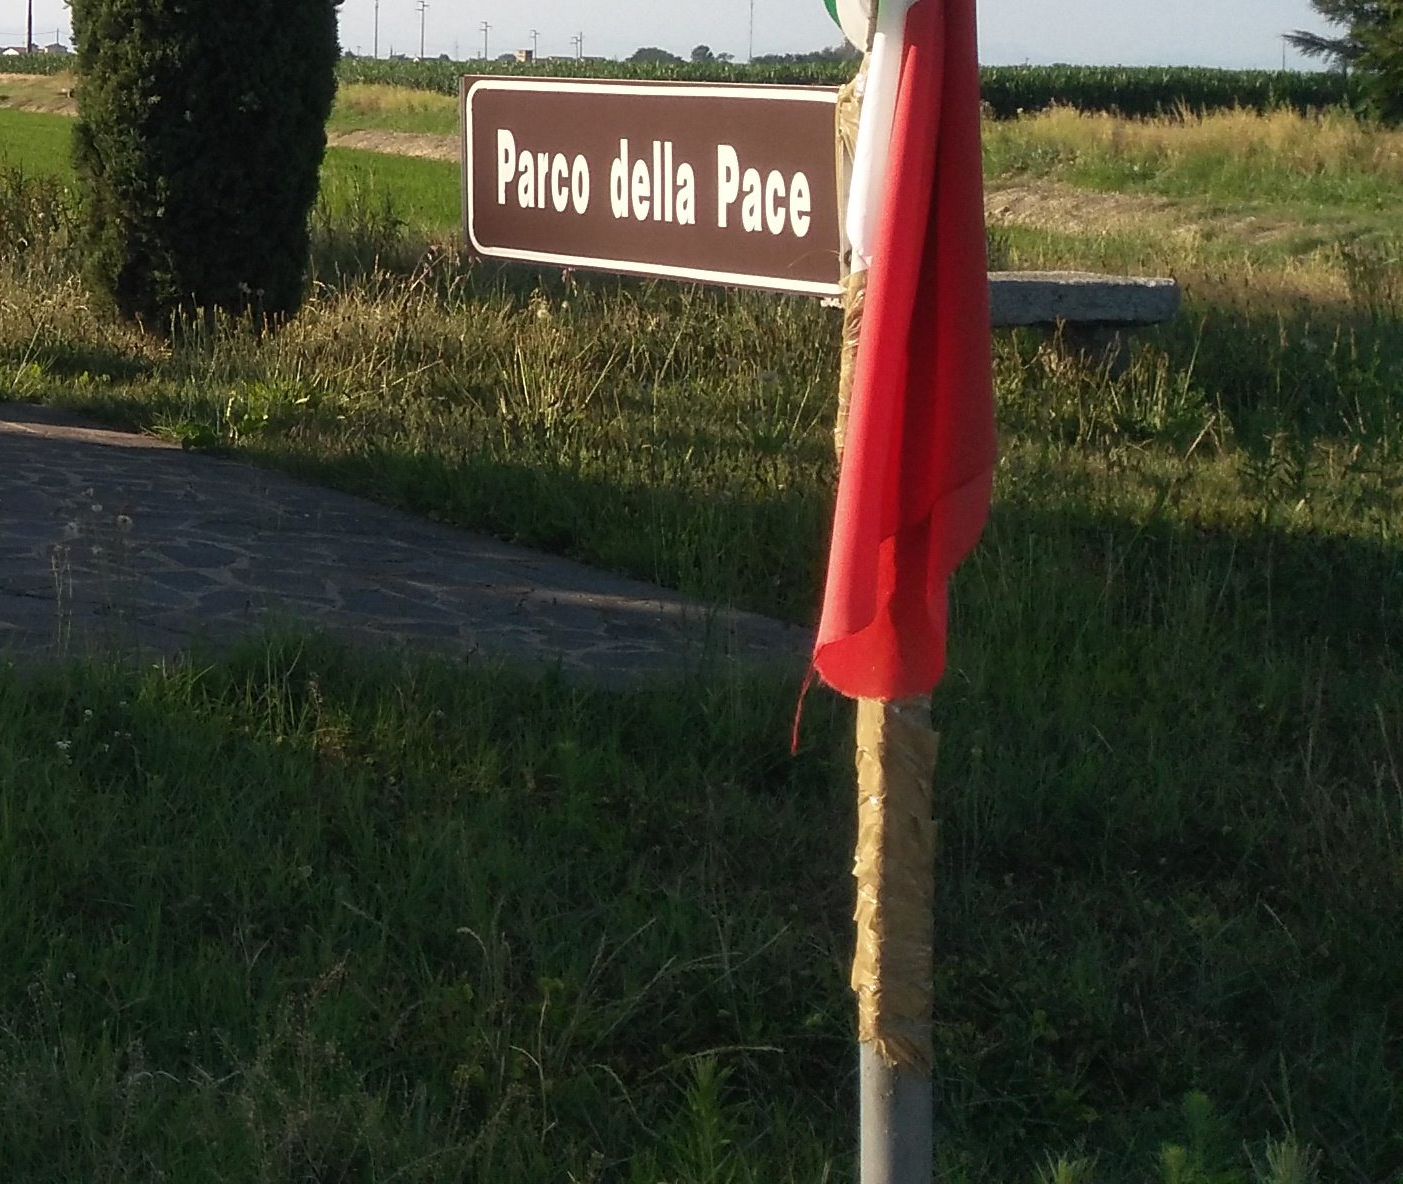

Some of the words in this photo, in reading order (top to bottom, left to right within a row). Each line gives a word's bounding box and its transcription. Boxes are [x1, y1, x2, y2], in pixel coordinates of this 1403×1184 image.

[496, 128, 590, 215] Parco
[610, 137, 696, 226] della
[716, 143, 813, 238] Pace
